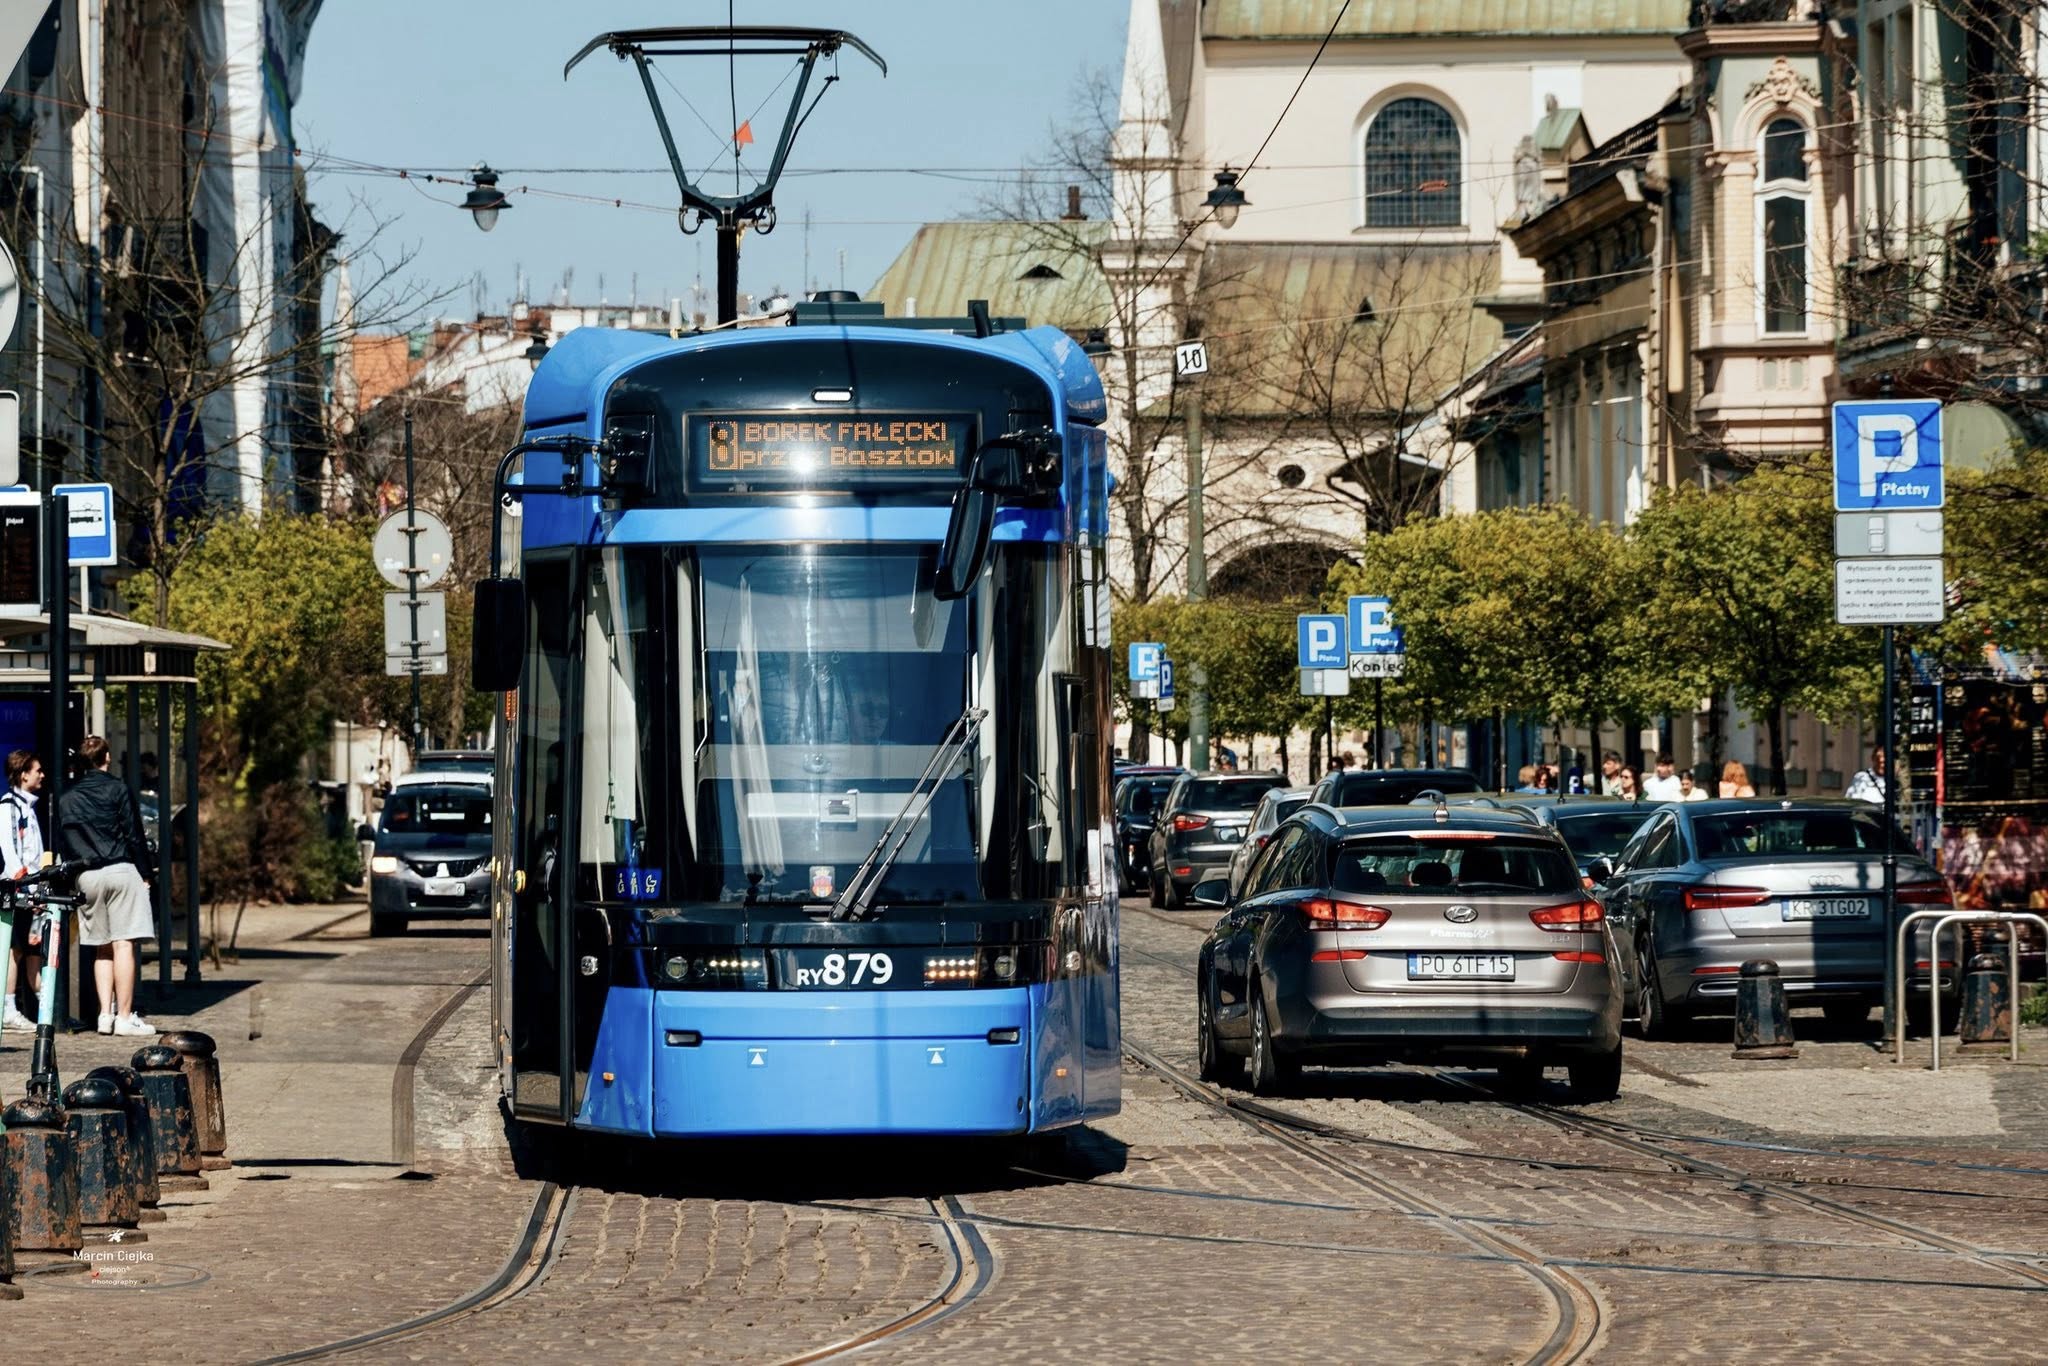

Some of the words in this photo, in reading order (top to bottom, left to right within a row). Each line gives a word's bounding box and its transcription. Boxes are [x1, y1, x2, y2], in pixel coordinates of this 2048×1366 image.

[1181, 349, 1202, 369] 10
[745, 422, 832, 442] BOREK
[838, 422, 947, 445] FAŁĘCKI
[709, 421, 739, 470] 8
[831, 446, 955, 466] Basztow
[1858, 414, 1918, 497] P
[1881, 482, 1930, 499] Płatny
[1360, 602, 1393, 647] P
[1308, 621, 1337, 662] P
[1351, 658, 1405, 673] Koniec
[1162, 664, 1171, 695] P
[1792, 901, 1814, 914] KR
[1818, 901, 1866, 915] 3TG02
[1452, 956, 1509, 973] 6TF15
